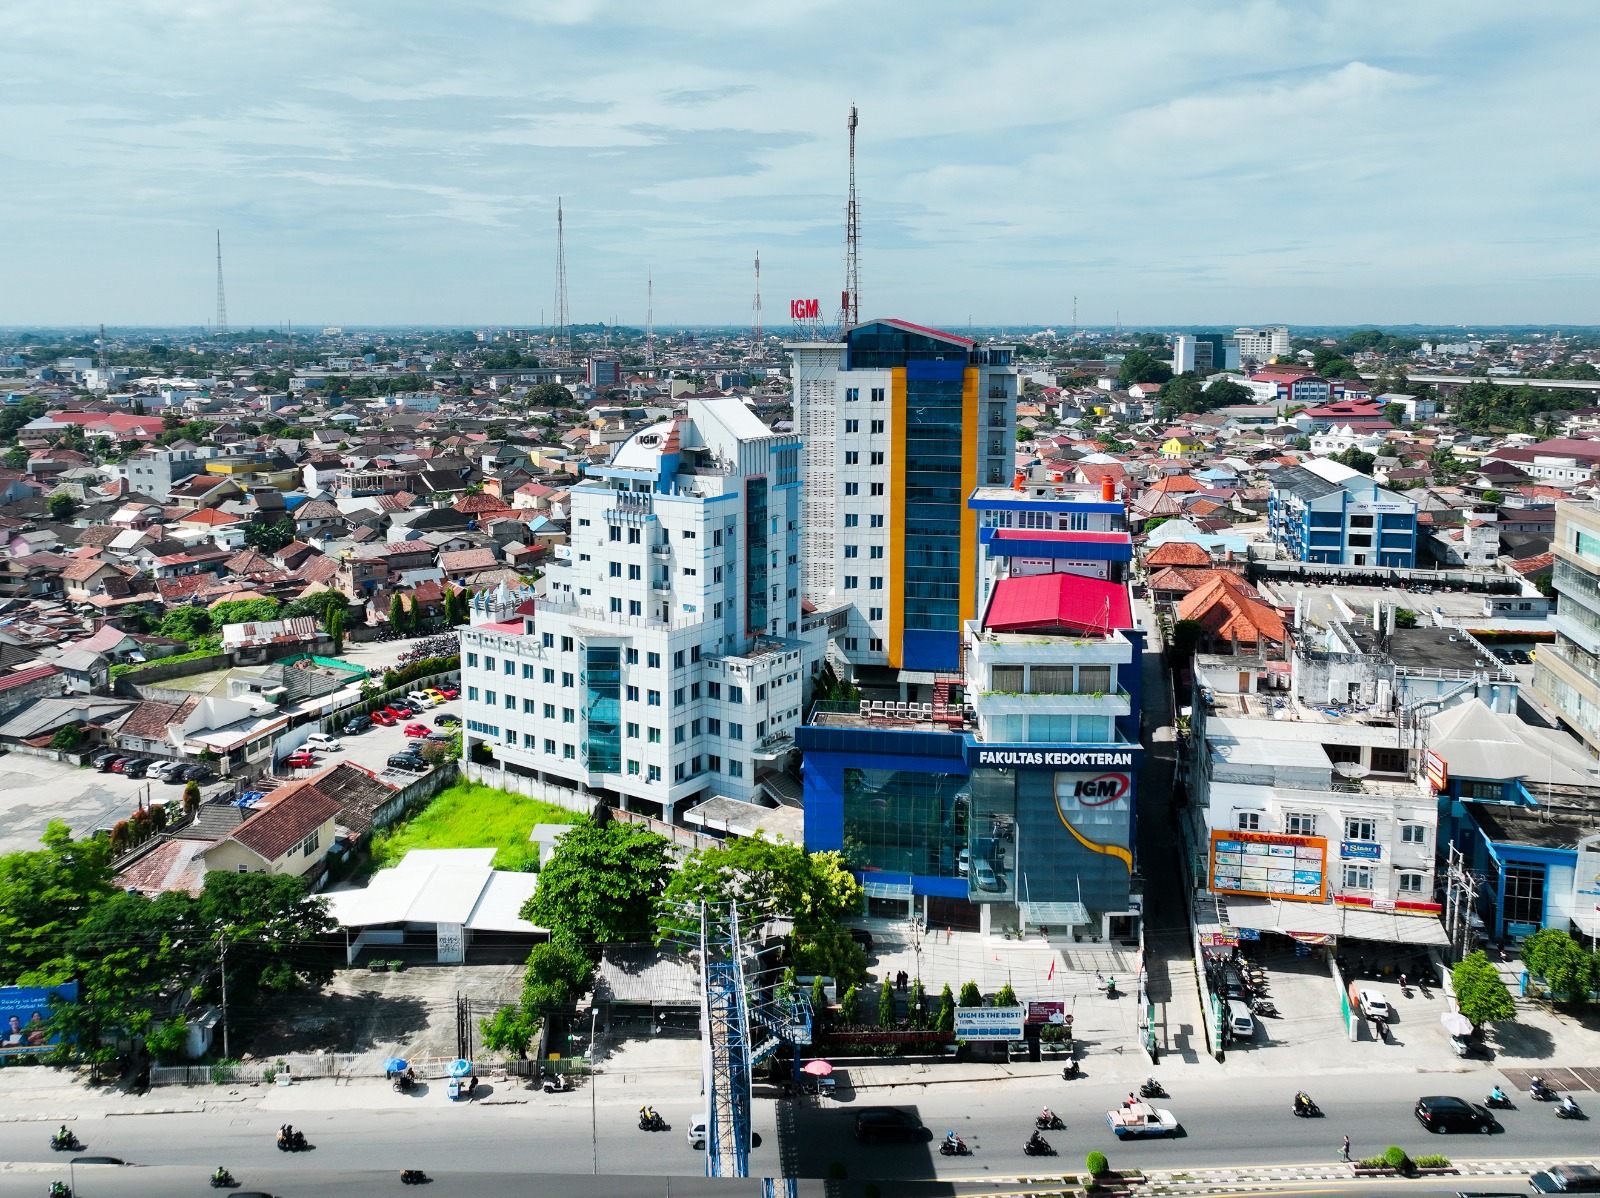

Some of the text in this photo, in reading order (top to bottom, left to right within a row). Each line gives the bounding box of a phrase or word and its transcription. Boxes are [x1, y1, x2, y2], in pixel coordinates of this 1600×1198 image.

[790, 299, 818, 319] IGM
[979, 751, 1132, 765] FAKULTAS KEDOKTERAN
[1073, 780, 1118, 797] IGM
[1228, 832, 1311, 845] SINAR STATIONERY
[1349, 844, 1372, 852] Sinar
